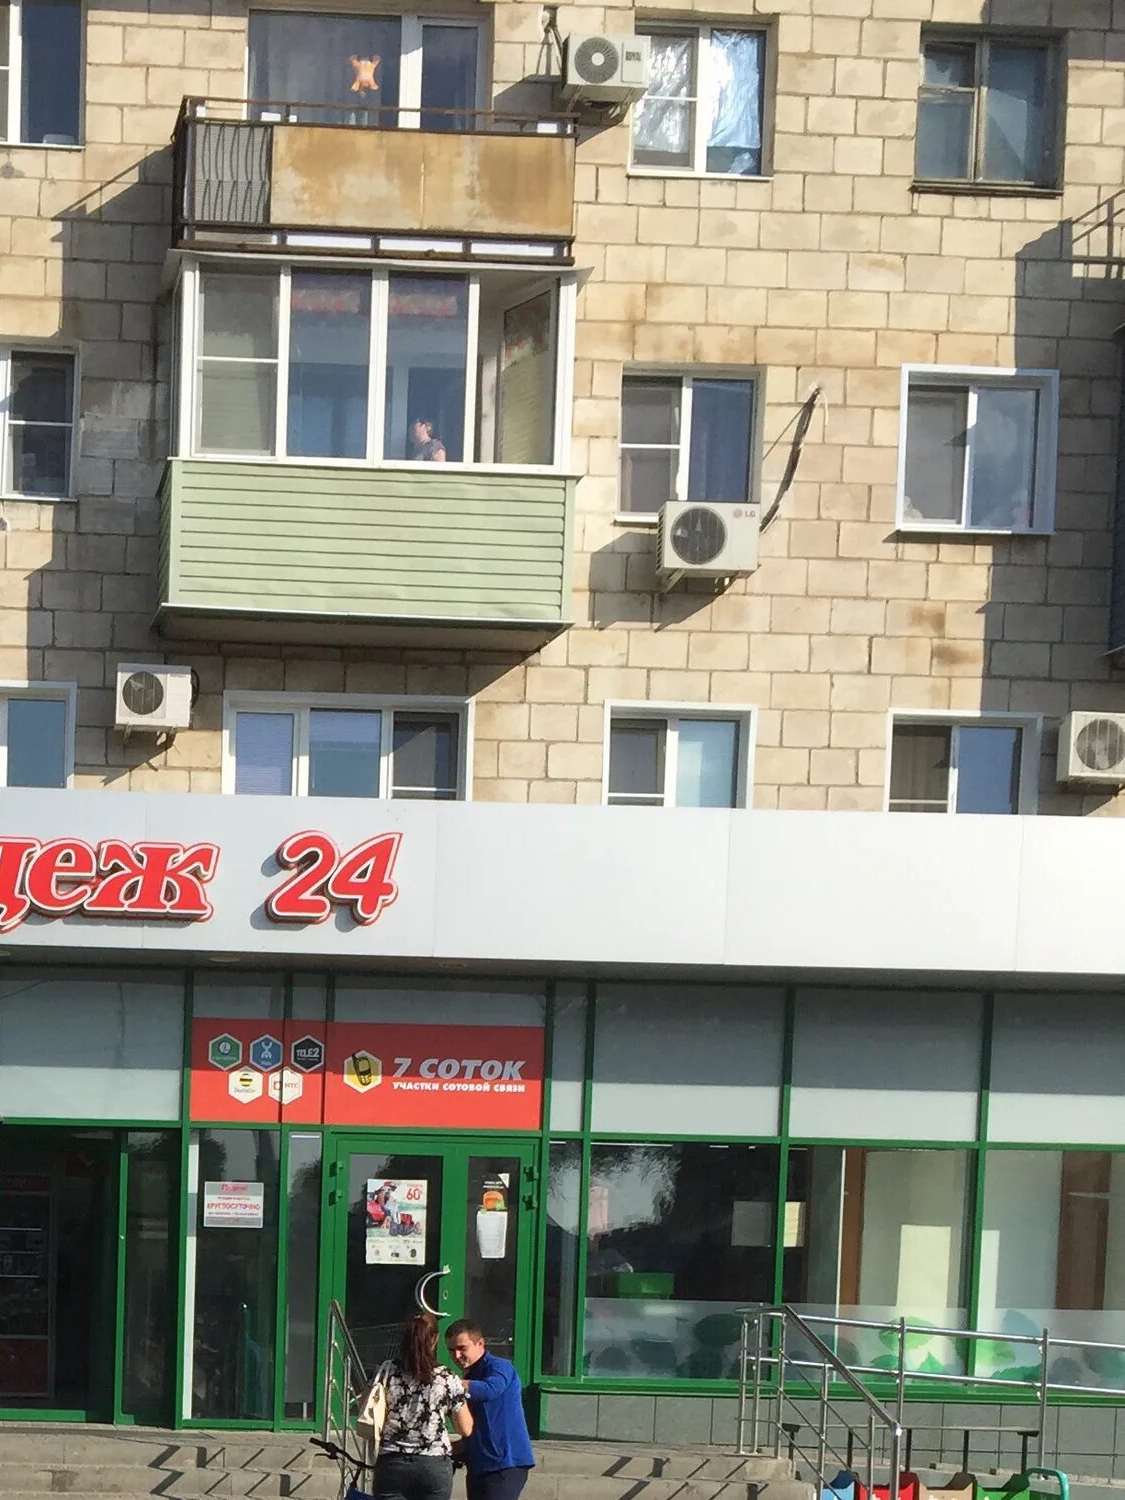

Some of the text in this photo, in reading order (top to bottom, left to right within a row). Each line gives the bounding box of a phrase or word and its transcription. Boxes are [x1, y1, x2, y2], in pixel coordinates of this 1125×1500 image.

[266, 831, 403, 925] 24
[296, 1047, 320, 1058] TELE2
[393, 1057, 526, 1081] 7 СОТОК
[392, 1081, 526, 1093] УЧАСТКИ СОТОВОЙ СВЯЗИ
